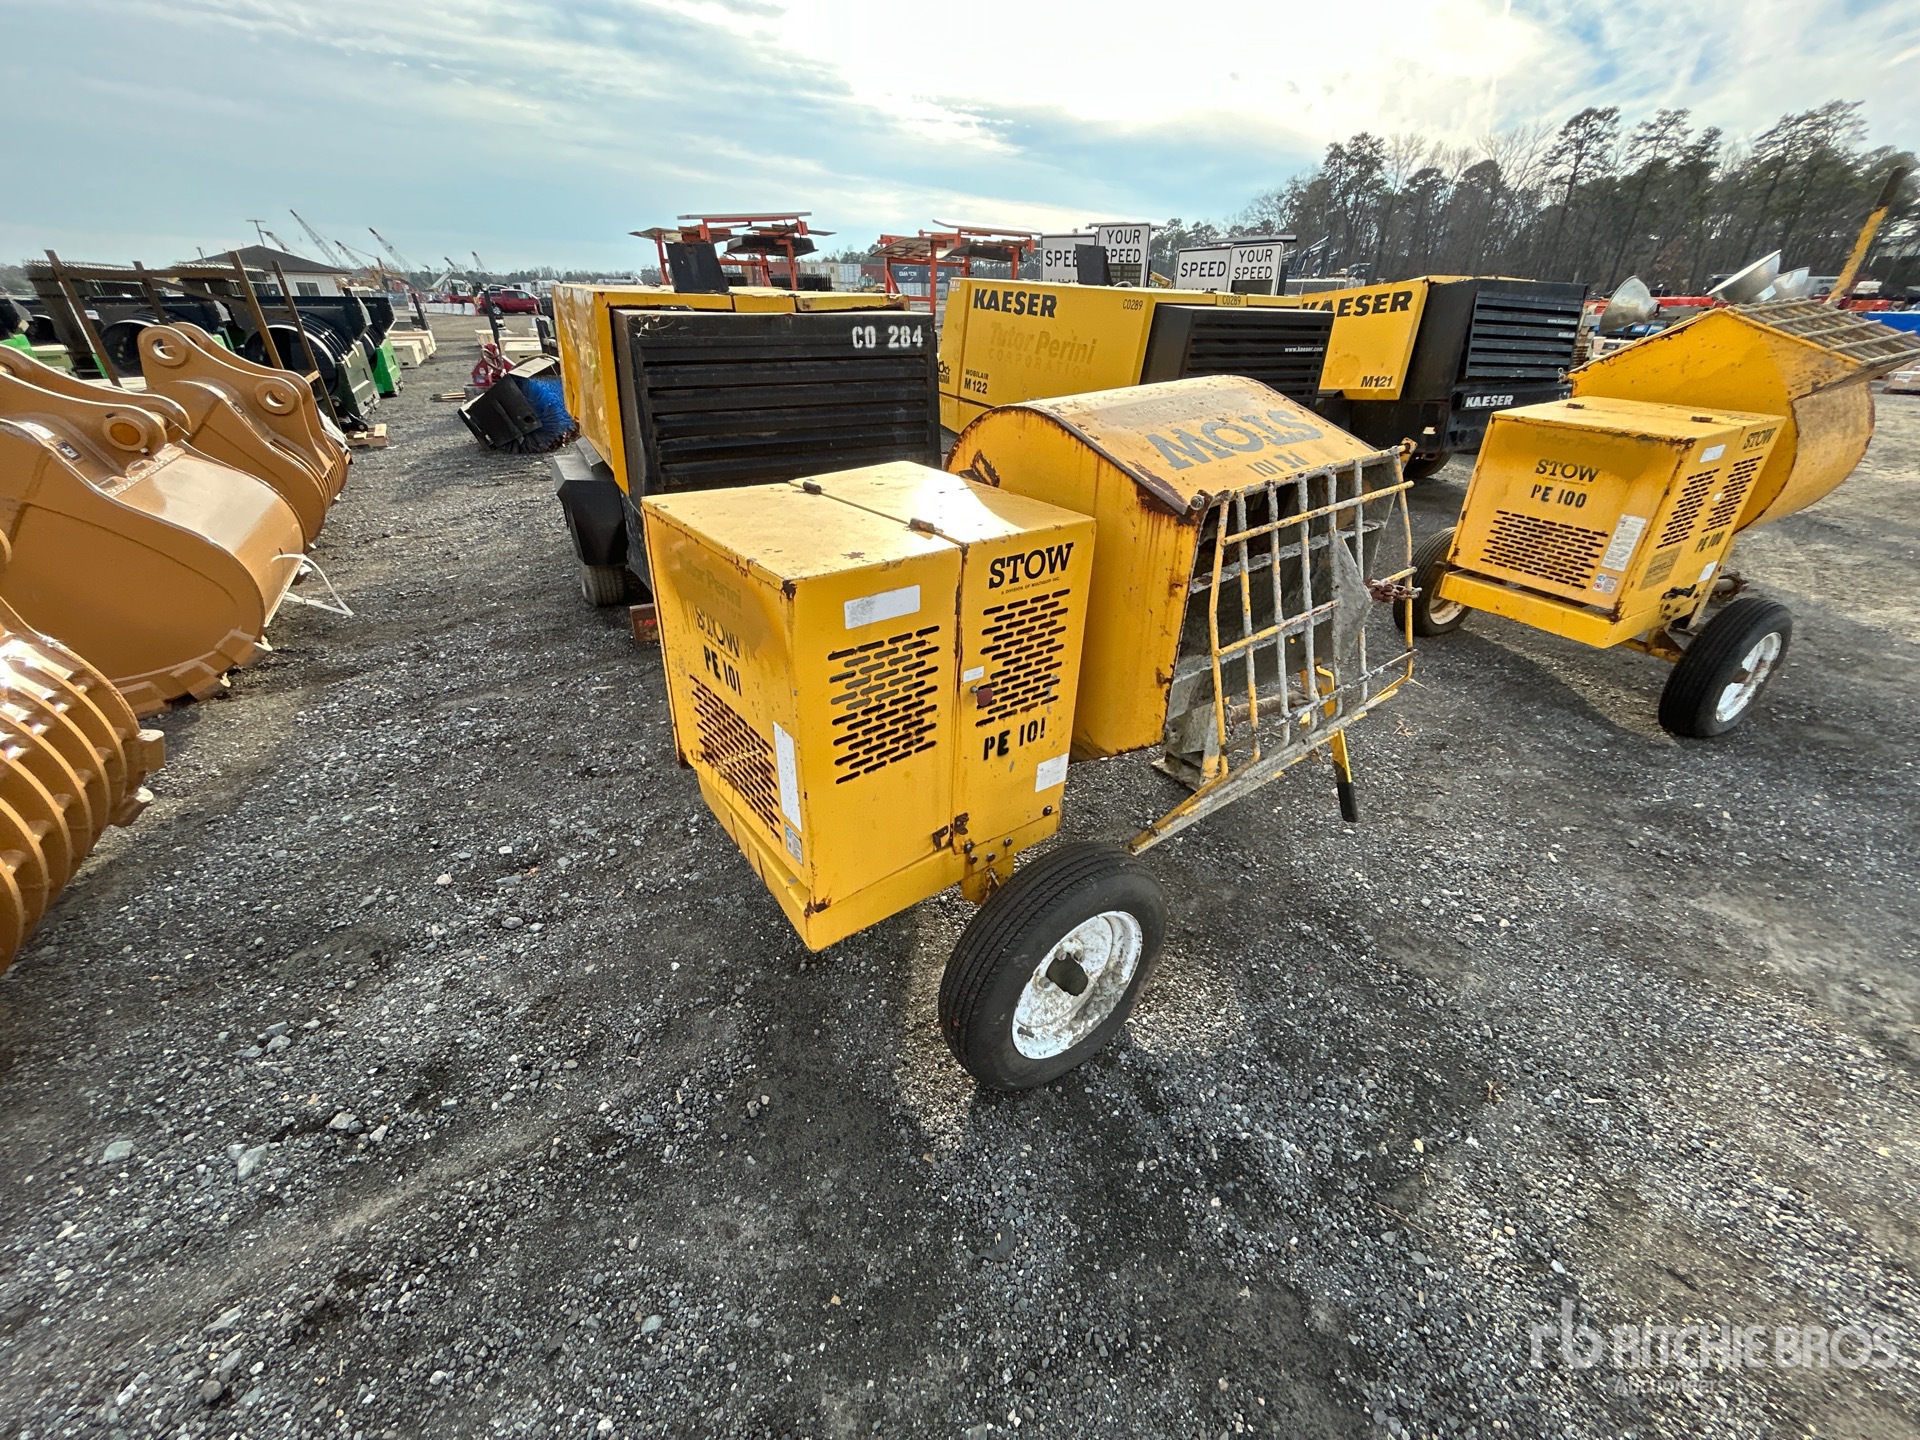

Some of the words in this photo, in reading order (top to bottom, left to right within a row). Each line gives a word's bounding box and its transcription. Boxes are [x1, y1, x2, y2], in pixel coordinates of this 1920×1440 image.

[1106, 229, 1141, 244] YOUR
[1045, 249, 1078, 267] SPEE
[1239, 248, 1273, 263] YOUR
[1180, 261, 1226, 278] SPEED
[1234, 266, 1273, 280] SPEED
[973, 288, 1058, 318] KAESER
[888, 325, 923, 348] 284
[990, 321, 1035, 352] Tutor
[1035, 330, 1098, 365] Perini
[963, 377, 972, 390] M
[972, 380, 988, 395] 122
[965, 368, 989, 381] MOBILAIR
[1360, 375, 1394, 388] M121
[1465, 395, 1514, 408] KAESER
[1145, 409, 1324, 471] STOW
[1743, 427, 1777, 450] STOW
[1535, 458, 1601, 483] STOW
[1530, 484, 1553, 503] PE
[1557, 489, 1588, 509] 100
[1693, 535, 1710, 554] PE
[1707, 531, 1725, 549] 100
[988, 542, 1075, 590] STOW
[694, 605, 740, 659] STOW
[703, 645, 721, 682] PE
[723, 660, 742, 697] 101
[983, 730, 1011, 761] PE
[1019, 716, 1047, 747] 101
